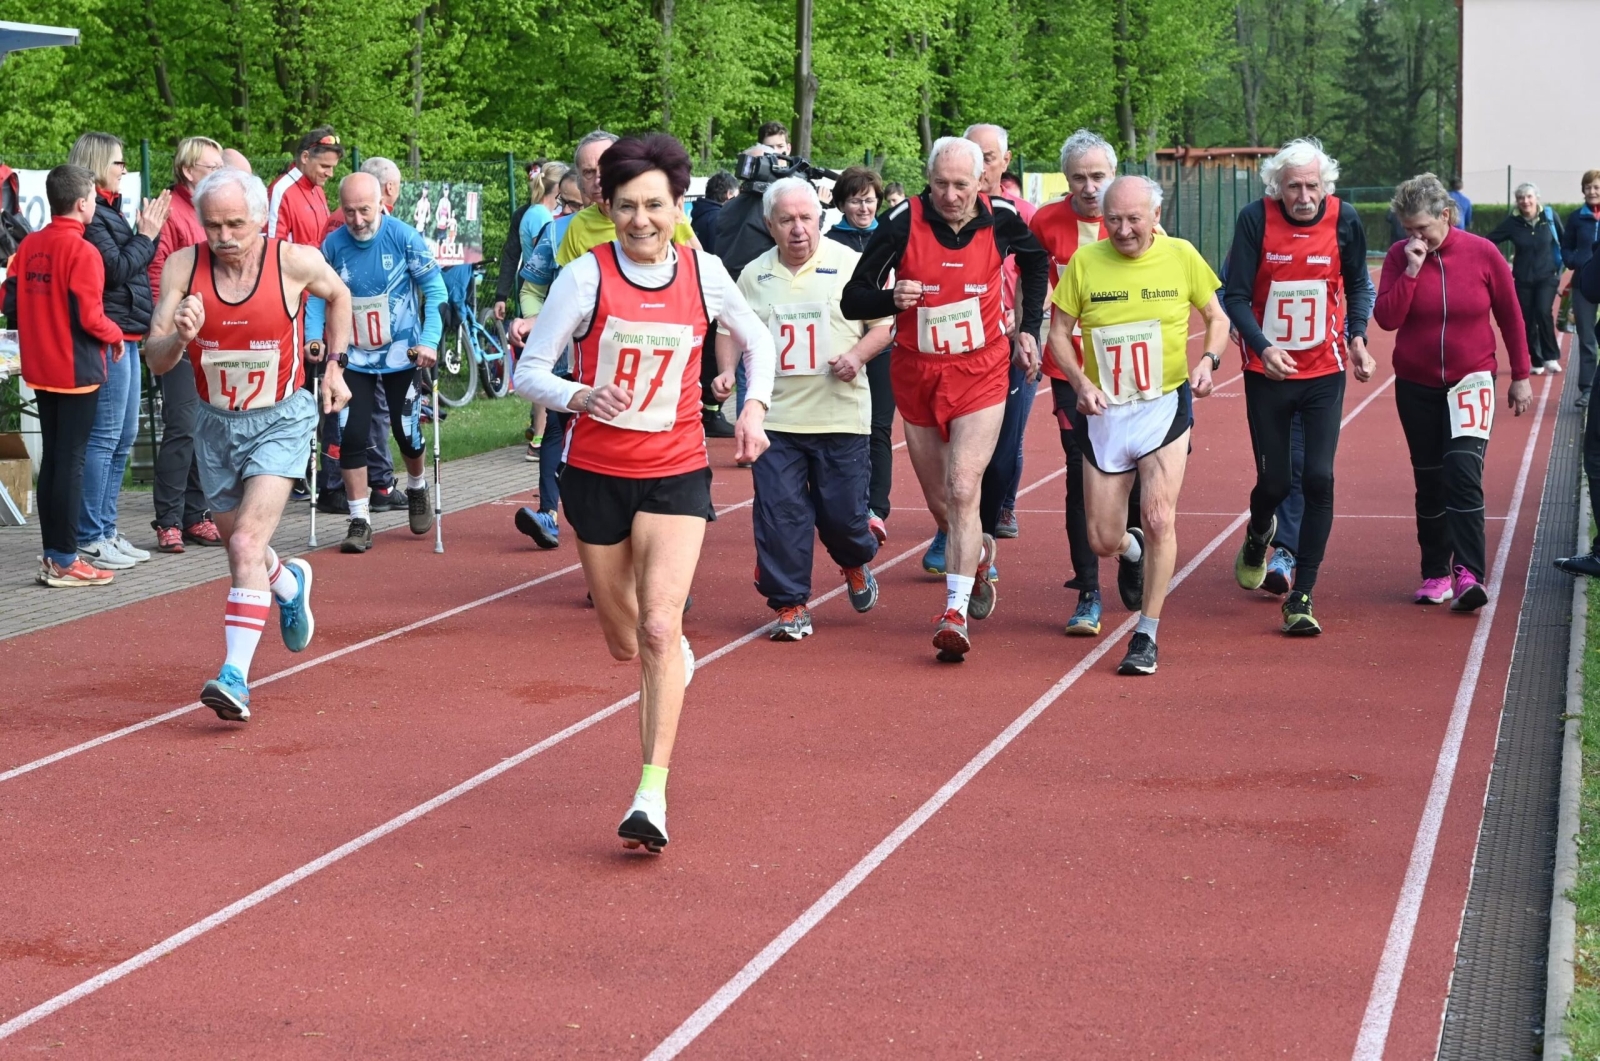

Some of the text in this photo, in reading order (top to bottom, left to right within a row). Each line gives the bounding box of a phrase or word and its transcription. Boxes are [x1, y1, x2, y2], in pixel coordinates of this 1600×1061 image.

[1090, 290, 1128, 298] MARATON
[1141, 288, 1178, 299] Krakonoš
[776, 311, 821, 321] PIVOVAR TRUTNOV
[925, 310, 972, 325] PIVOVAR TRUTNOV
[1276, 298, 1316, 342] 53
[613, 331, 643, 345] PIVOVAR
[646, 335, 681, 347] TRUTNOV
[780, 323, 815, 370] 21
[1102, 332, 1153, 346] PIVOVAR TRUTNOV
[213, 360, 270, 370] PIVOVAR TRUTNOV
[1106, 341, 1150, 396] 70
[613, 348, 674, 412] 87
[219, 369, 265, 411] 42
[1457, 388, 1491, 431] 58
